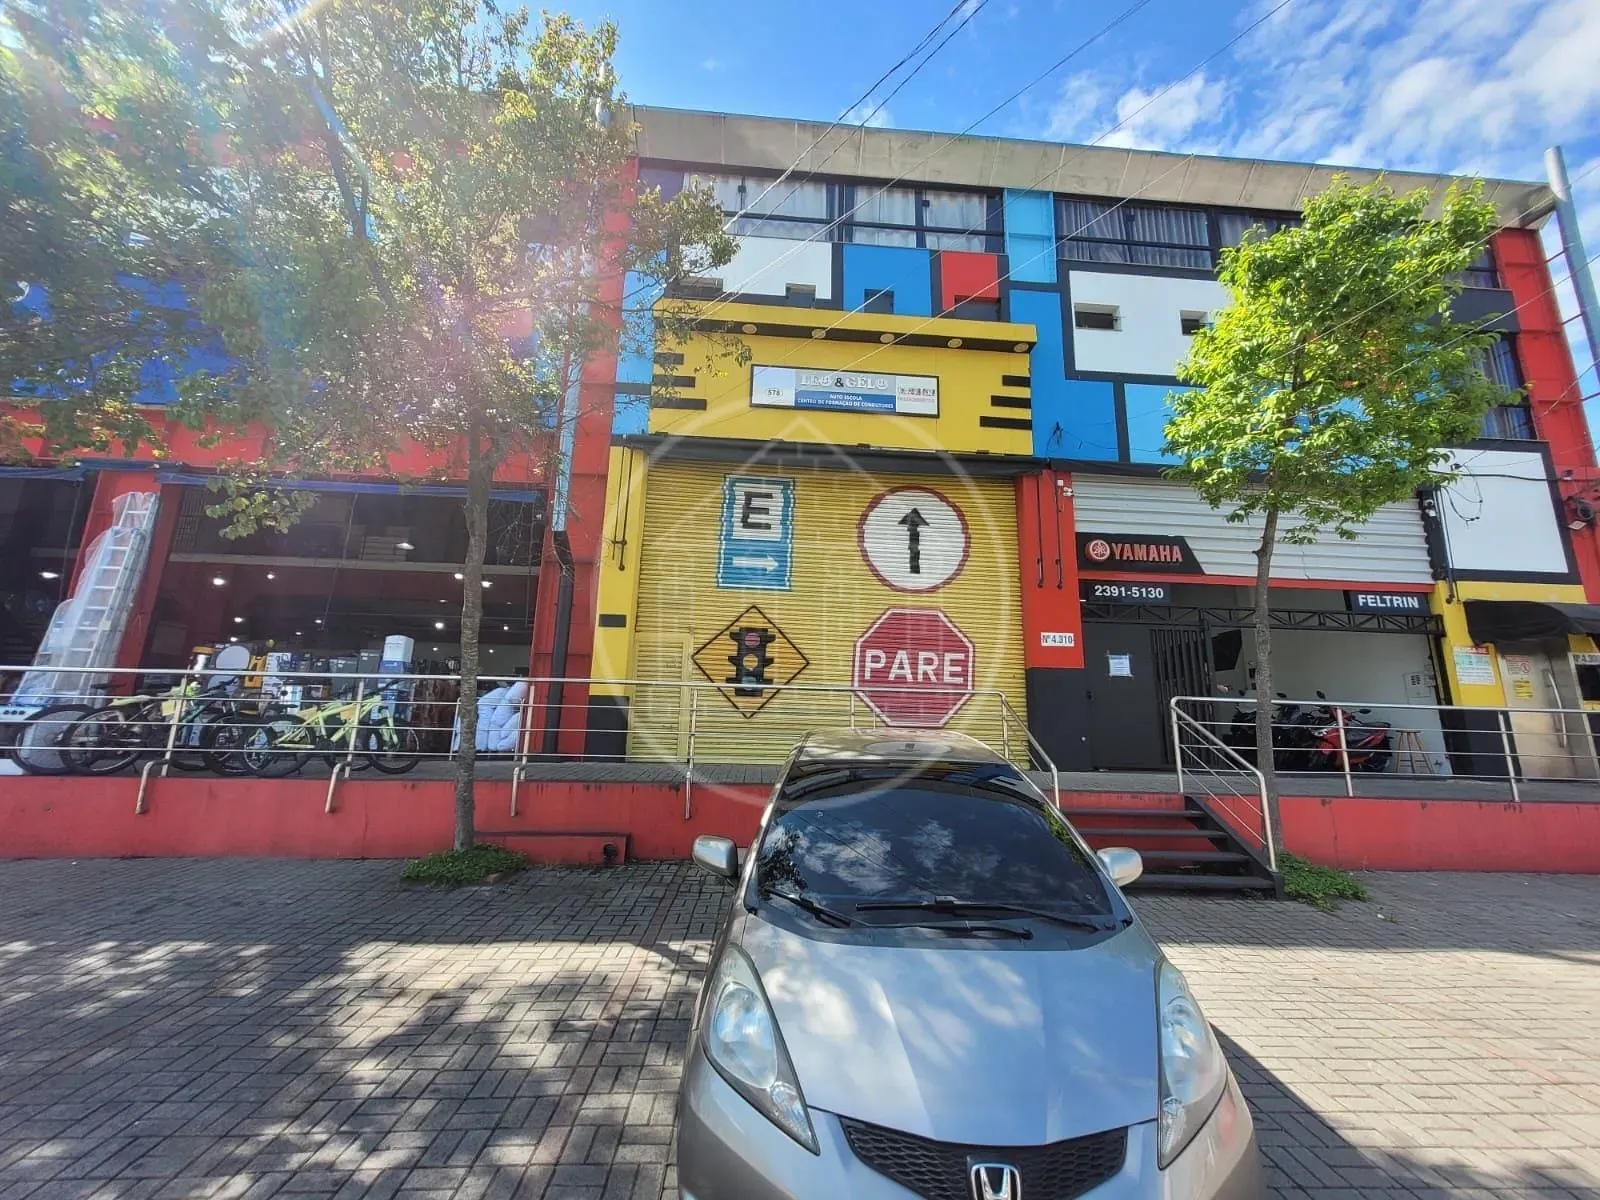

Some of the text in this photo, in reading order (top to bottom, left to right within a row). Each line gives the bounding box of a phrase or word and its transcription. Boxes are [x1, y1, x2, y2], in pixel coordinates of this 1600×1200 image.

[834, 377, 845, 388] &
[740, 490, 774, 530] E
[1112, 543, 1183, 562] YAMAHA
[1094, 585, 1164, 599] 2391-5130
[1358, 594, 1419, 609] FELTRIN
[863, 649, 966, 684] PARE
